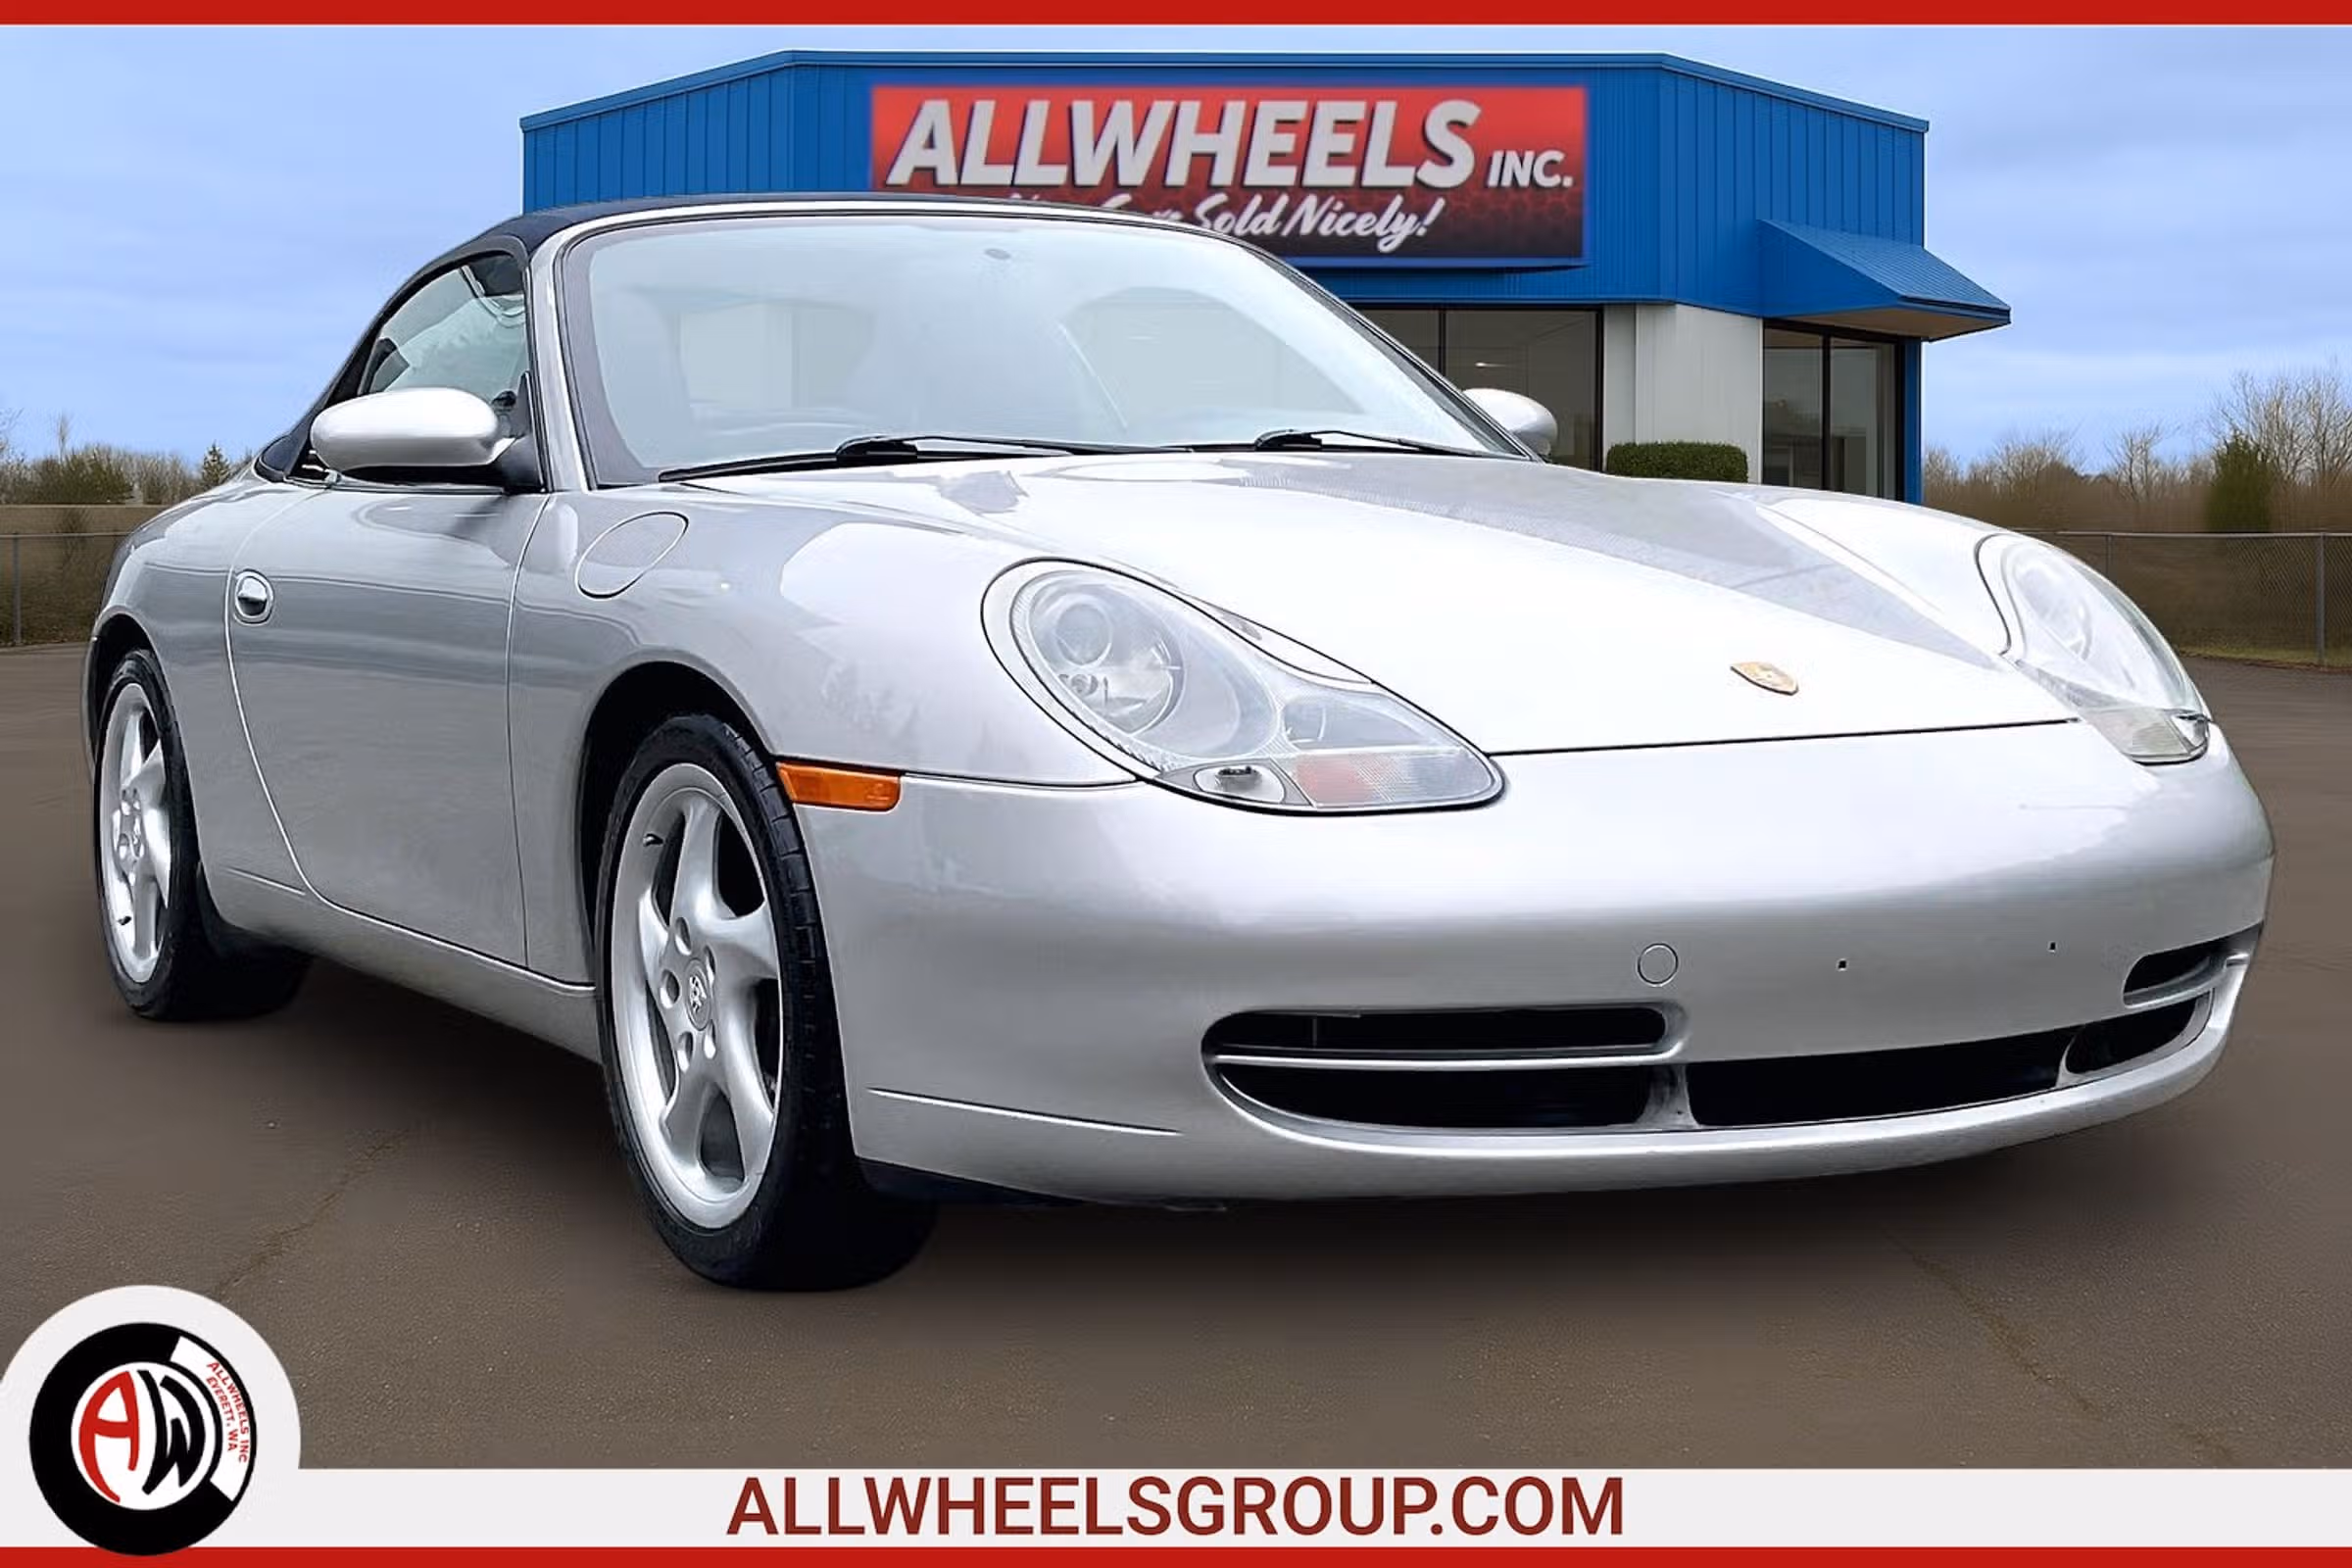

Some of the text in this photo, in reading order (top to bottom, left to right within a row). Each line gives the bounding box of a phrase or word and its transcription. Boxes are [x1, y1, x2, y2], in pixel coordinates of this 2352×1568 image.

[885, 99, 1574, 189] ALLWHEELS INC.
[1193, 192, 1282, 238] Sold
[1282, 193, 1446, 253] Nicely!
